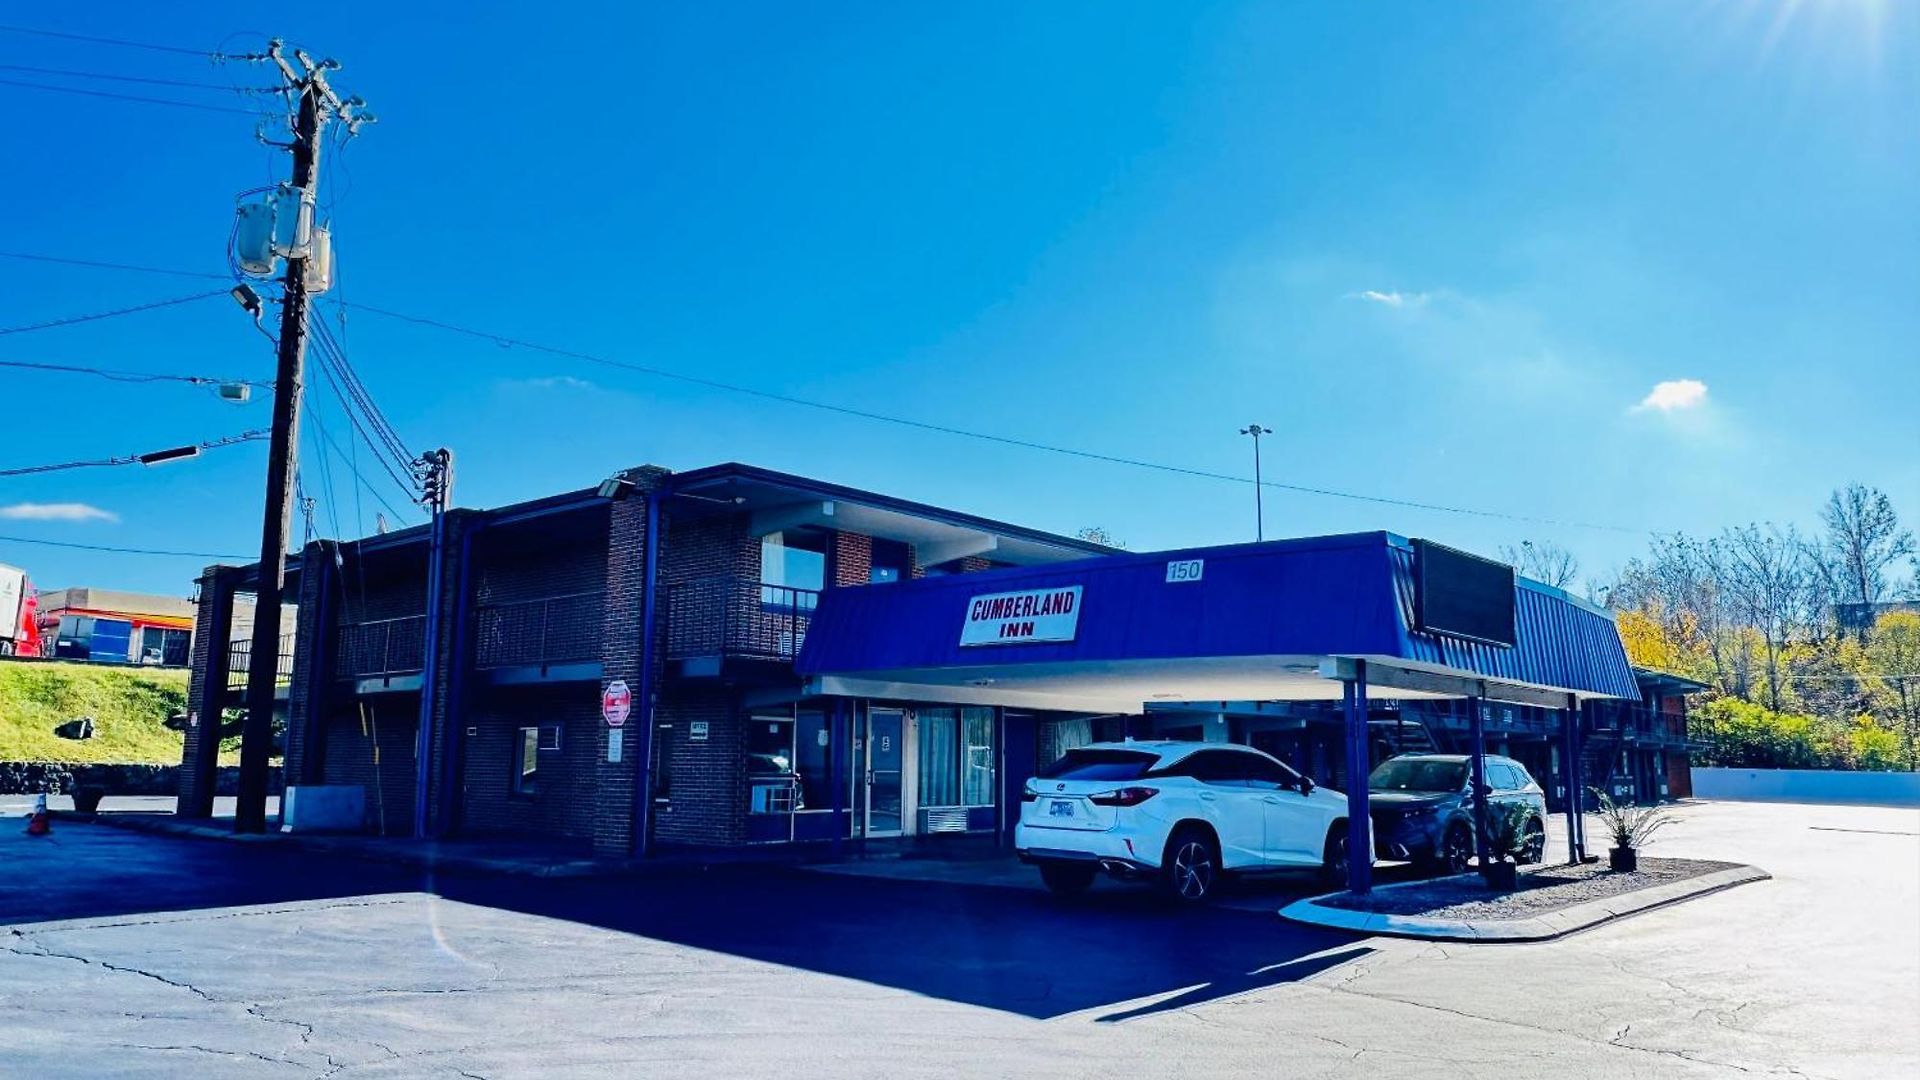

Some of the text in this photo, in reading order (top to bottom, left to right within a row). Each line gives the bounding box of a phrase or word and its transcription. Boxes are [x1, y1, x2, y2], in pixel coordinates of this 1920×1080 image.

[1170, 561, 1200, 579] 150
[971, 591, 1075, 622] CUMBERLAND
[999, 622, 1035, 638] INN
